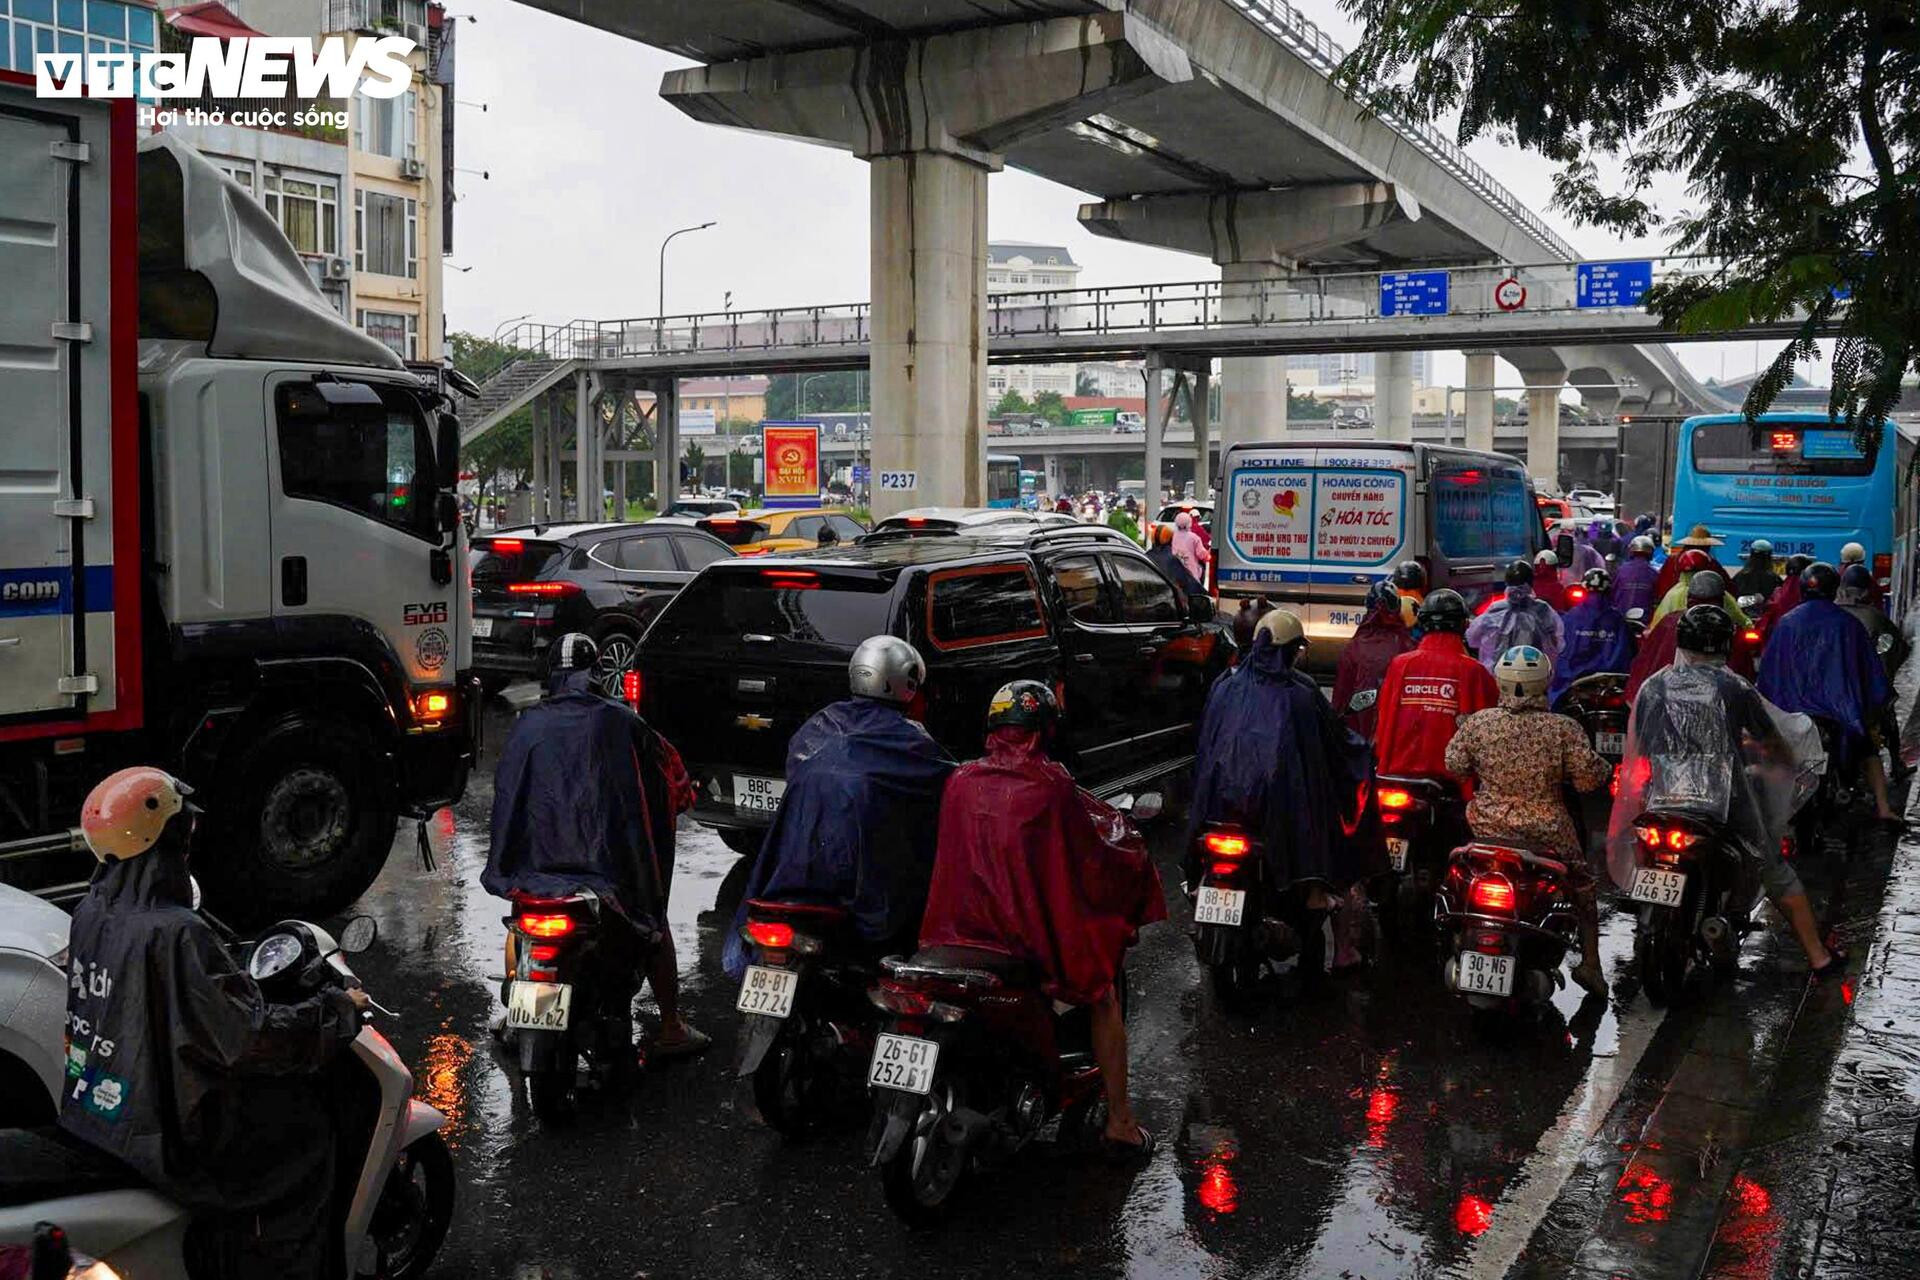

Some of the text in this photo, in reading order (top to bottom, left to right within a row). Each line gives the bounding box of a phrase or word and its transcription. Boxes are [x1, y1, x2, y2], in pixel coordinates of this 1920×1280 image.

[1241, 458, 1305, 467] HOTLINE
[881, 473, 915, 488] P237
[1366, 506, 1394, 526] TỐC
[403, 601, 447, 615] FVR
[402, 612, 448, 626] 900
[1404, 684, 1439, 695] CIRCLE
[748, 779, 773, 794] 88C
[1641, 871, 1680, 888] 29-L5
[1204, 890, 1238, 907] 88-C1
[1197, 905, 1240, 924] 381.86
[1468, 955, 1507, 974] 30-N6
[1468, 972, 1504, 992] 1941
[740, 989, 789, 1014] 237.24
[882, 1038, 929, 1065] 26-G1
[872, 1060, 930, 1090] 252.61
